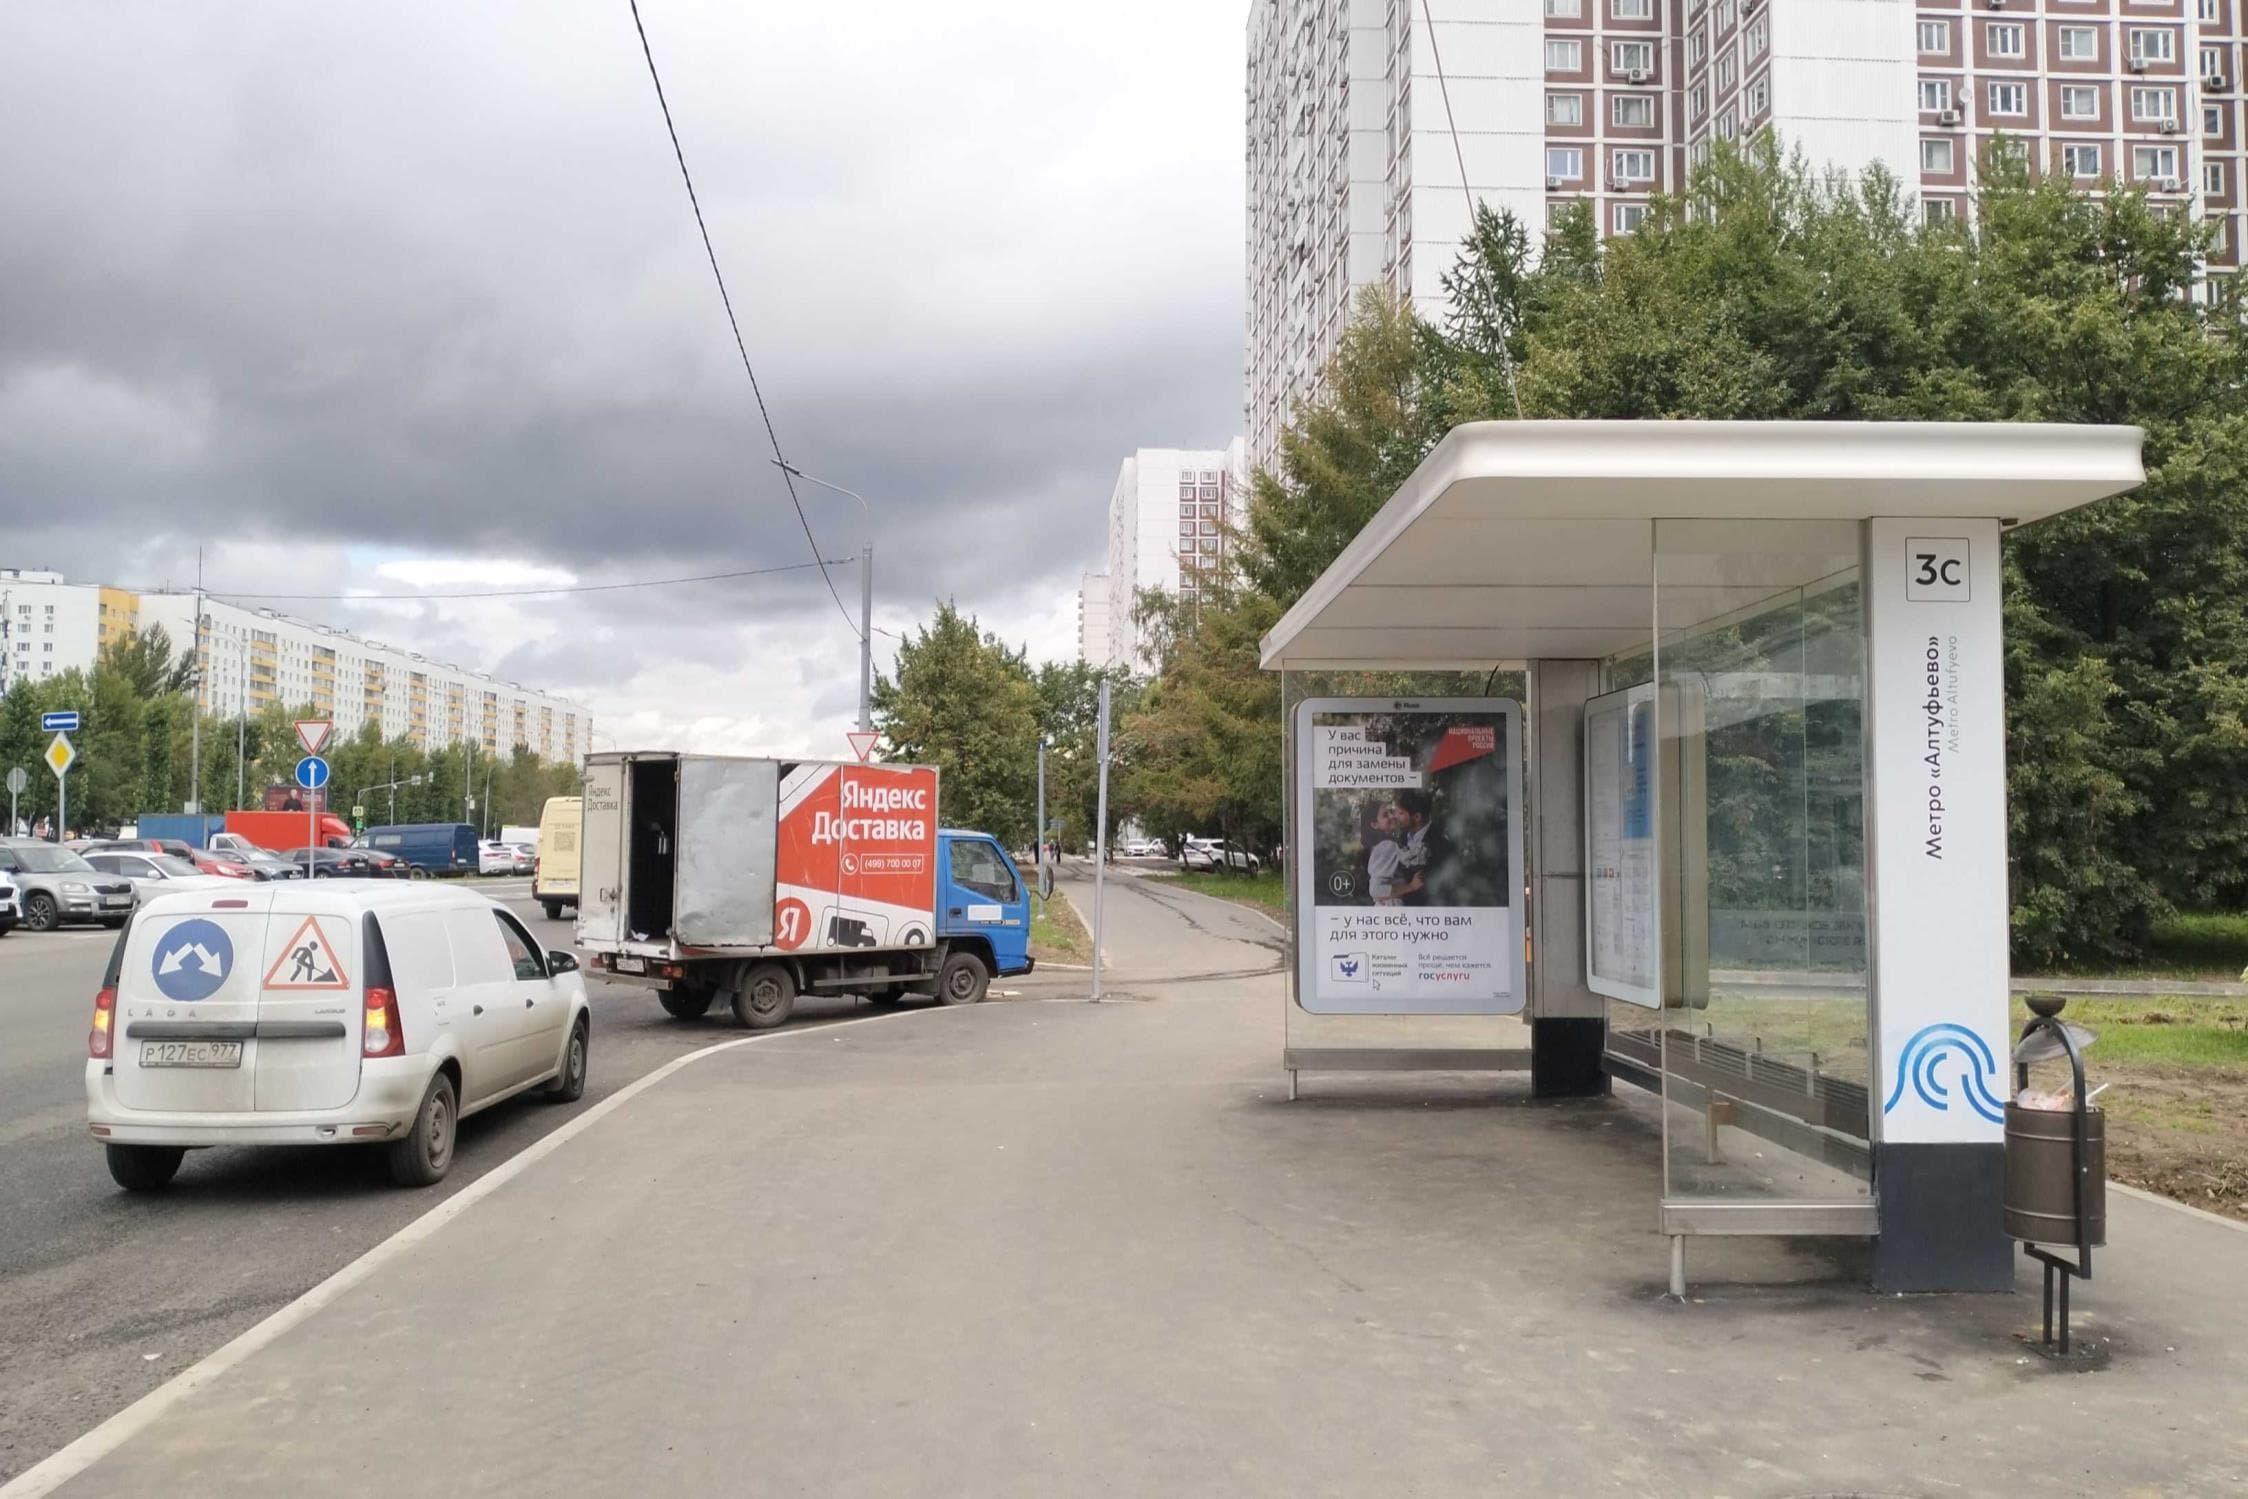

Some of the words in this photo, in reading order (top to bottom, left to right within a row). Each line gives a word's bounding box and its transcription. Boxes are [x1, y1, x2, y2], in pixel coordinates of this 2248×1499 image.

[1945, 635, 1961, 704] Altufyevo
[1922, 636, 1944, 778] «Алтуфьево»
[1328, 729, 1336, 741] У
[1340, 732, 1361, 741] вас
[1947, 708, 1960, 754] Metro
[1328, 746, 1382, 756] причина
[1328, 760, 1352, 770] для
[1356, 760, 1406, 769] замены
[1328, 774, 1405, 785] документов
[588, 785, 611, 797] Яндекс
[844, 780, 926, 812] Яндекс
[587, 799, 618, 813] Доставка
[812, 811, 925, 845] Доставка
[1926, 785, 1945, 859] Метро
[1333, 876, 1350, 891] 0+
[776, 906, 801, 941] Я
[1344, 916, 1352, 927] у
[1356, 916, 1381, 926] нас
[1385, 913, 1412, 927] всё,
[1416, 916, 1440, 926] что
[1444, 916, 1472, 926] вам
[1329, 930, 1357, 942] для
[1362, 930, 1398, 941] этого
[1402, 930, 1449, 943] нужно
[128, 1009, 197, 1017] LADA
